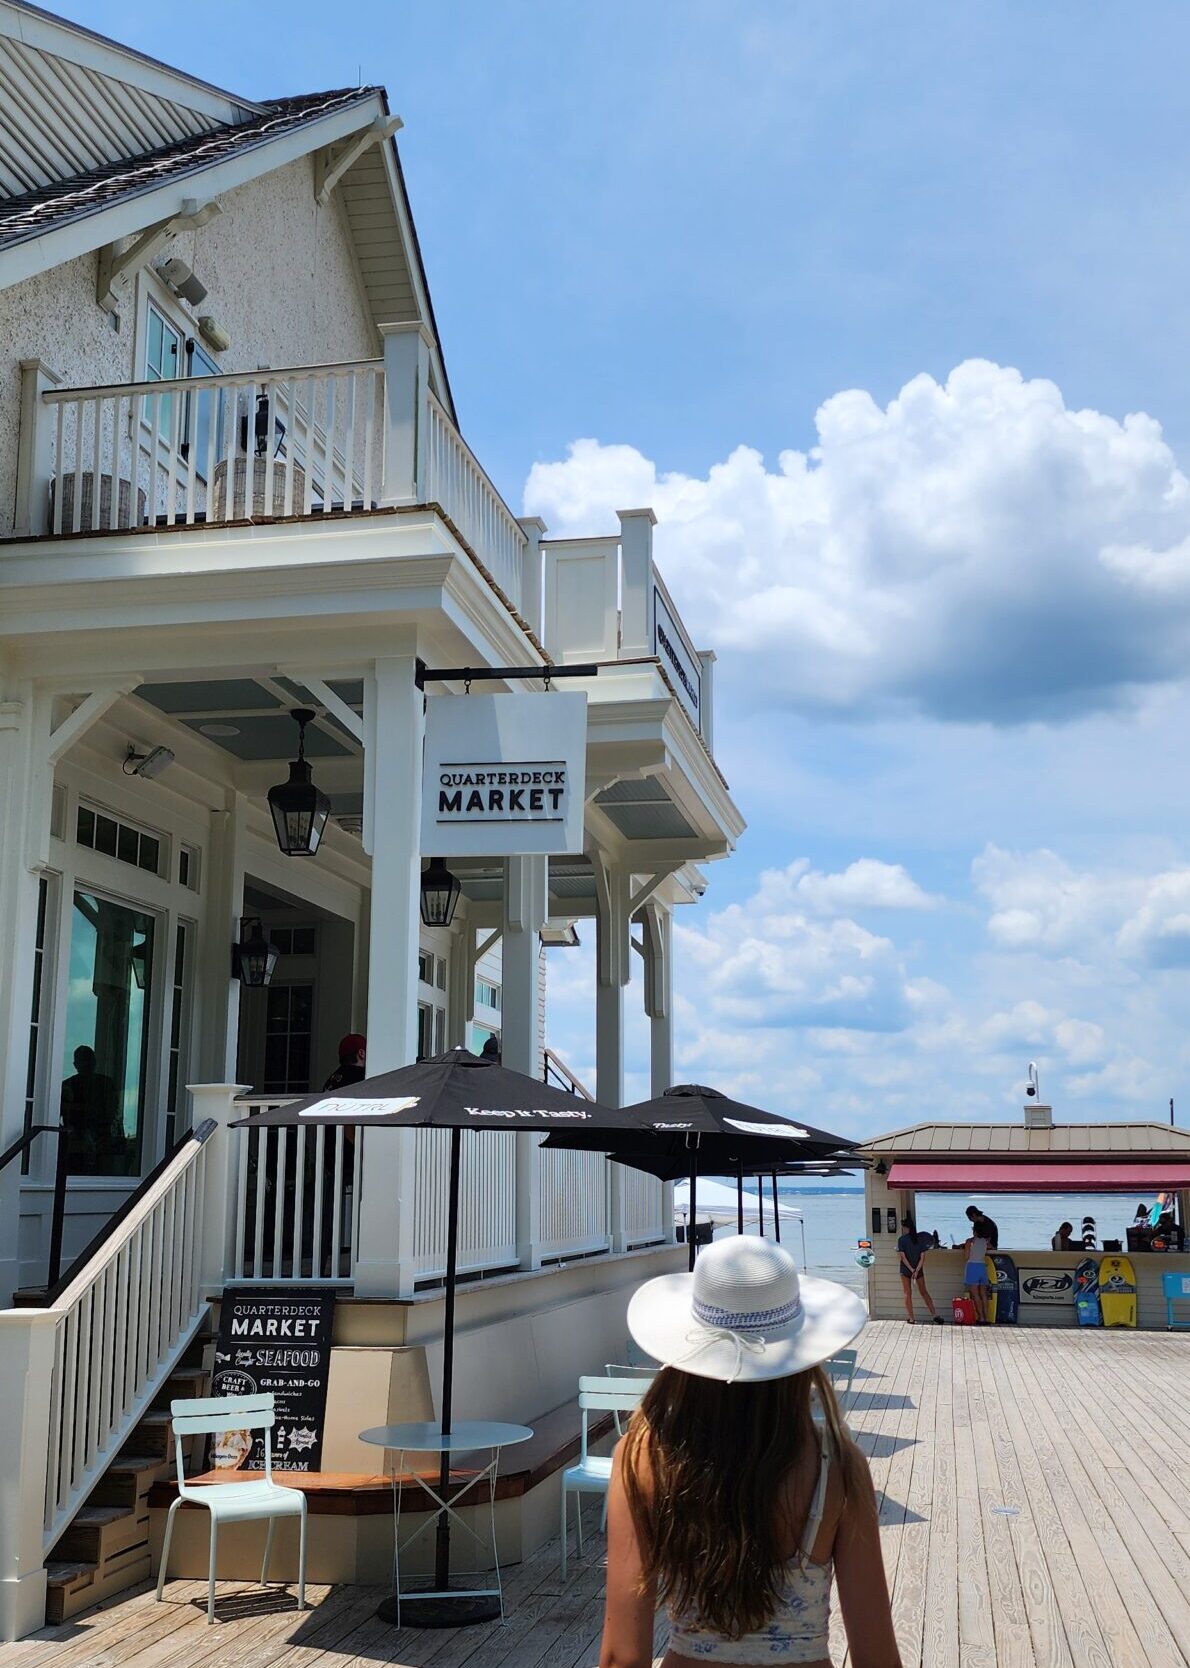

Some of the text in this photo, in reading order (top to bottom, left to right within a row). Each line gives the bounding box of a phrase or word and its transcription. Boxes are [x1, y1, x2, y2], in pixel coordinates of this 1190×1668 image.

[439, 771, 566, 787] QUARTERDECK
[438, 788, 564, 813] MARKET
[464, 1107, 516, 1118] Keep
[233, 1305, 322, 1316] QUARTERDECK
[231, 1318, 320, 1337] MARKET
[256, 1349, 321, 1367] SEAFOOD
[222, 1376, 247, 1386] CRAFT
[260, 1378, 321, 1388] GRAB-AND-GO
[221, 1383, 240, 1392] BEER
